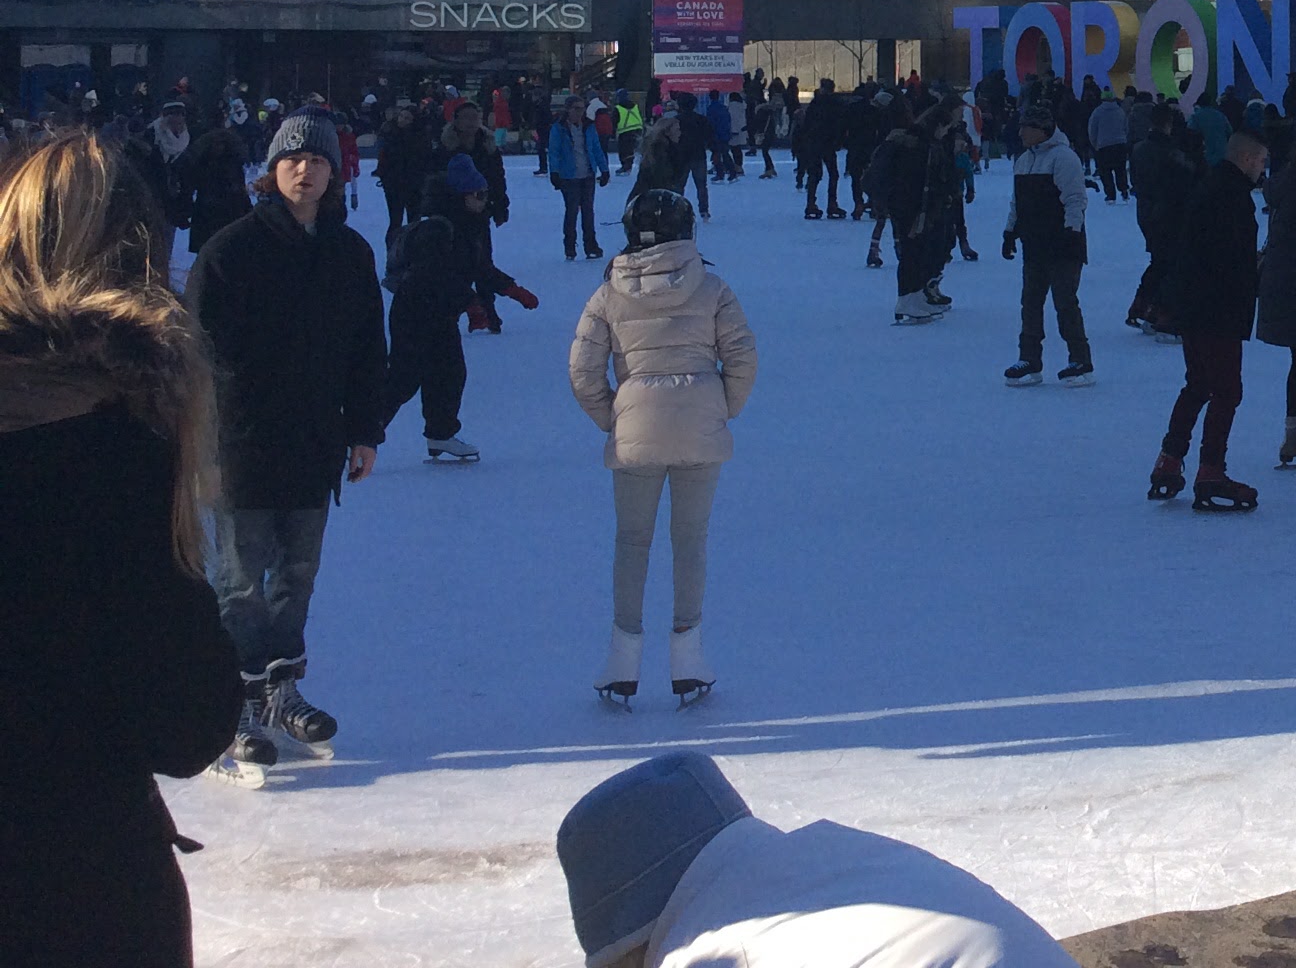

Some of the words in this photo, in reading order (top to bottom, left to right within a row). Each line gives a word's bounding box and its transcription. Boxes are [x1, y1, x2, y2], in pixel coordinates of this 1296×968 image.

[676, 2, 724, 10] CANADA
[410, 1, 586, 29] SNACKS
[697, 11, 724, 20] LOVE
